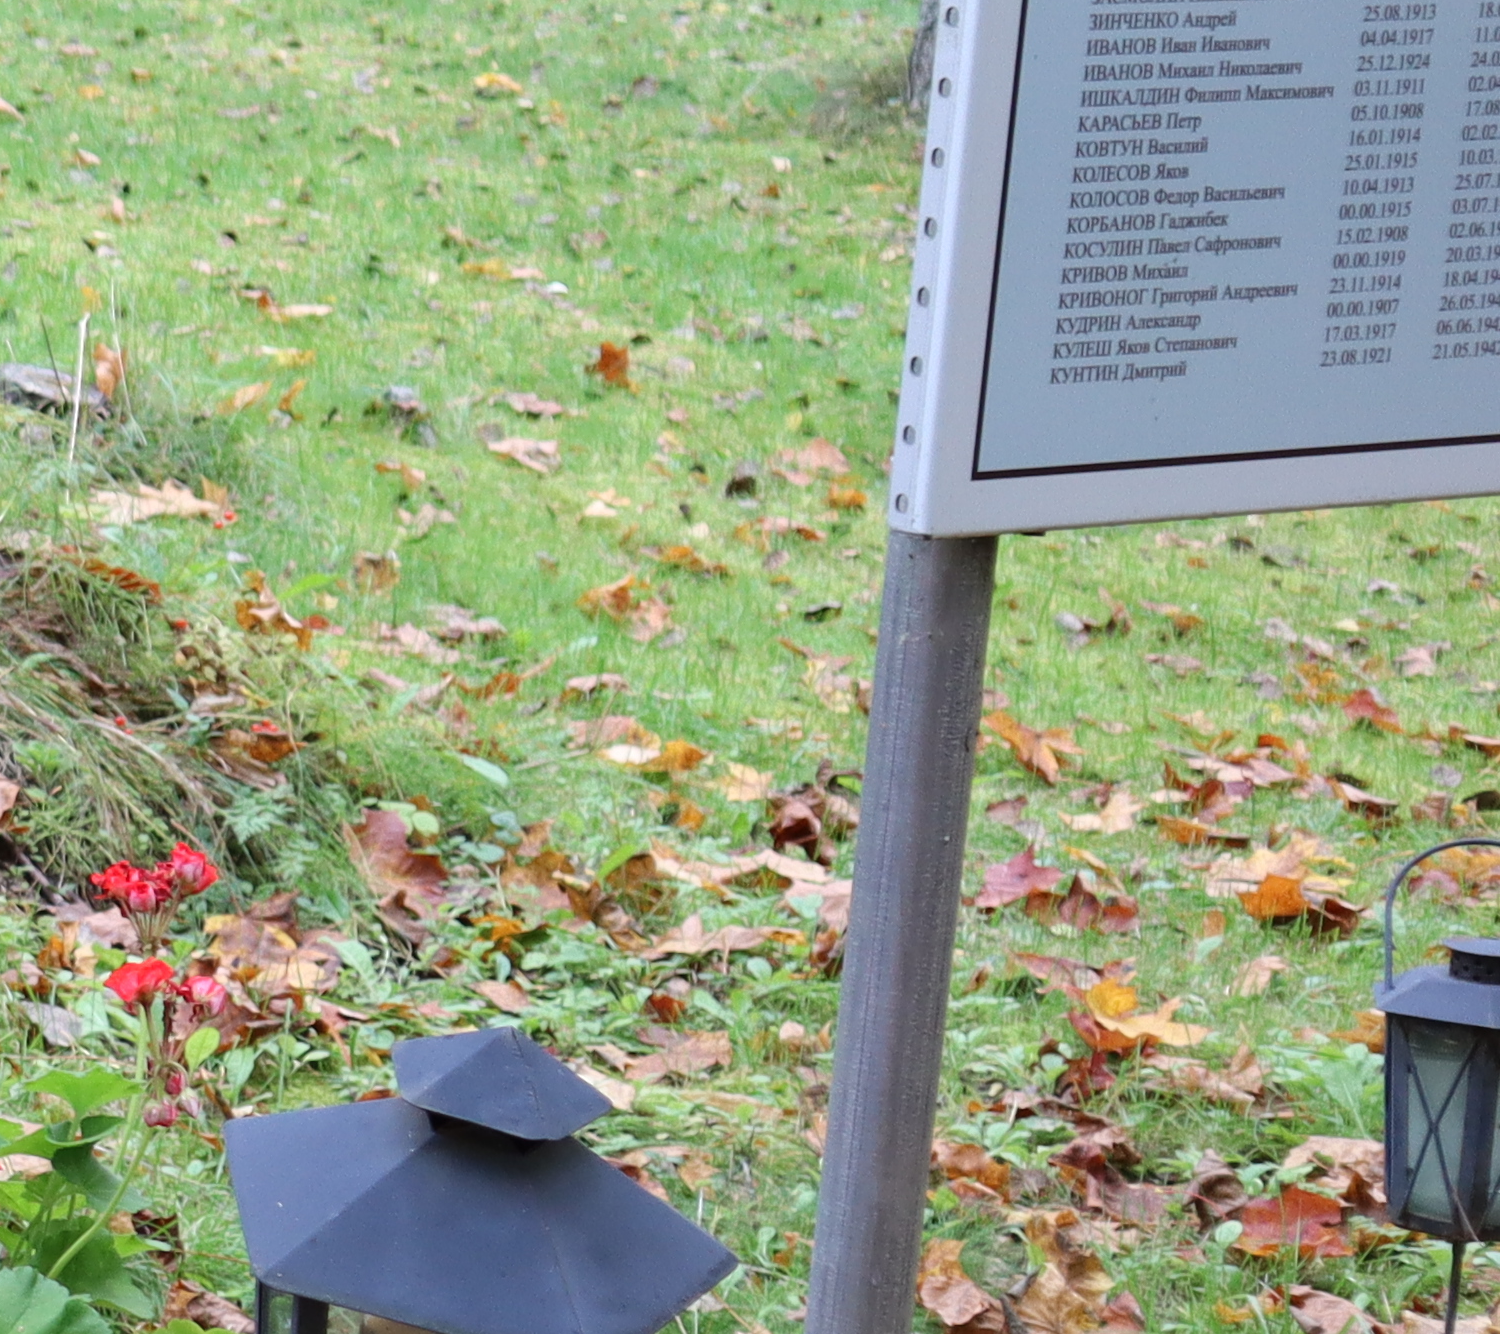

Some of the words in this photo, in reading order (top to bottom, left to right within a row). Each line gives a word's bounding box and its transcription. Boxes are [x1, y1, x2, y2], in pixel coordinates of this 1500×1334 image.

[1089, 12, 1179, 31] ЗИНЧЕНКО
[1183, 10, 1238, 32] Андрей
[1363, 3, 1437, 23] 25.08.1913
[1086, 38, 1157, 57] ИВАНОВ
[1162, 37, 1197, 54] Иван
[1202, 35, 1271, 53] Иванович
[1360, 27, 1435, 48] 04.04.1917
[1083, 63, 1154, 82] ИВАНОВ
[1159, 62, 1215, 79] Михаил
[1219, 60, 1303, 77] Николаевич
[1356, 53, 1431, 73] 25.12.1924
[1245, 84, 1335, 102] Максимович
[1353, 78, 1425, 97] 03.11.1911
[1077, 113, 1162, 134] КАРАСЬЕВ
[1167, 112, 1203, 133] Петр
[1351, 102, 1425, 122] 05.10.1908
[1075, 139, 1144, 159] КОВТУН
[1148, 136, 1209, 155] Василий
[1350, 127, 1421, 147] 16.01.1914
[1072, 164, 1151, 184] КОЛЕСОВ
[1155, 163, 1190, 180] Яков
[1344, 151, 1418, 172] 25.01.1915
[1069, 189, 1150, 210] КОЛОСОВ
[1154, 188, 1200, 208] Федор
[1203, 185, 1286, 203] Васильевич
[1343, 176, 1415, 196] 10.04.1913
[1339, 200, 1412, 221] 00.00.1915
[1063, 239, 1144, 260] КОСУЛИН
[1148, 238, 1192, 255] Павел
[1194, 234, 1282, 256] Сафронович
[1337, 225, 1410, 246] 15.02.1908
[1061, 265, 1128, 285] КРИВОВ
[1134, 264, 1189, 280] Михаил
[1333, 249, 1407, 270] 00.00.1919
[1058, 288, 1149, 310] КРИВОНОГ
[1152, 285, 1219, 308] Григорий
[1222, 283, 1299, 302] Андреевич
[1329, 274, 1402, 295] 23.11.1914
[1056, 315, 1121, 336] КУДРИН
[1126, 314, 1202, 330] Александр
[1326, 297, 1400, 319] 00.00.1907
[1053, 340, 1112, 360] КУЛЕШ
[1116, 339, 1151, 356] Яков
[1155, 336, 1238, 354] Степанович
[1325, 322, 1397, 343] 17.03.1917
[1050, 364, 1120, 385] КУНТИН
[1122, 360, 1188, 383] Дмитрий
[1320, 347, 1392, 368] 23.08.1921
